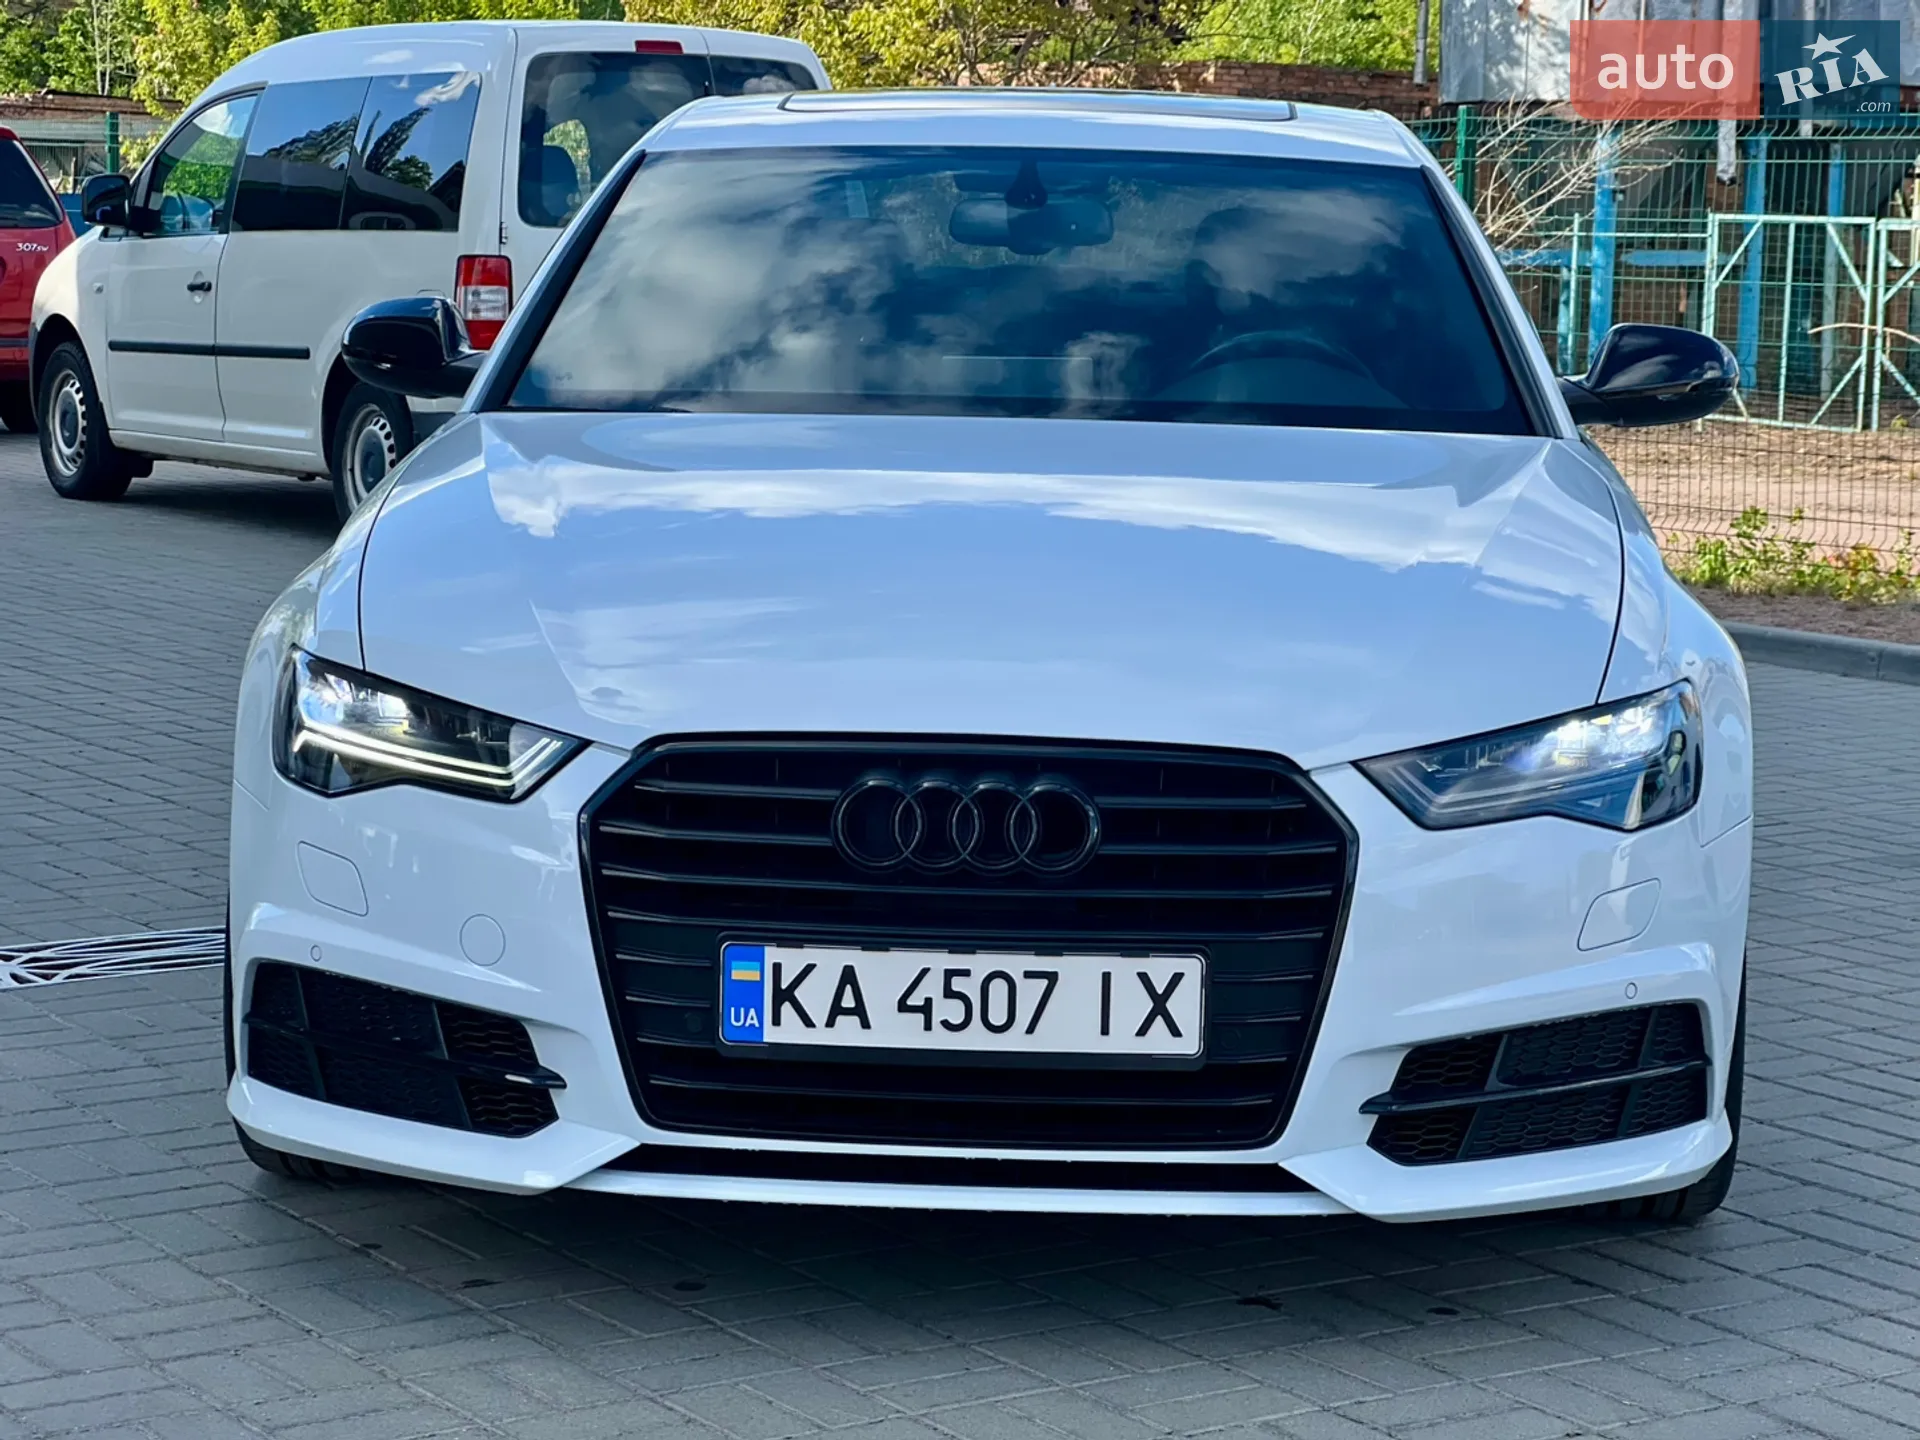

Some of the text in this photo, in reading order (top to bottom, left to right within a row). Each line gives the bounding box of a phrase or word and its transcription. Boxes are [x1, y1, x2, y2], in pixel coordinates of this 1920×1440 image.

[731, 1007, 760, 1028] UA
[771, 961, 1186, 1038] KA 4507 IX
